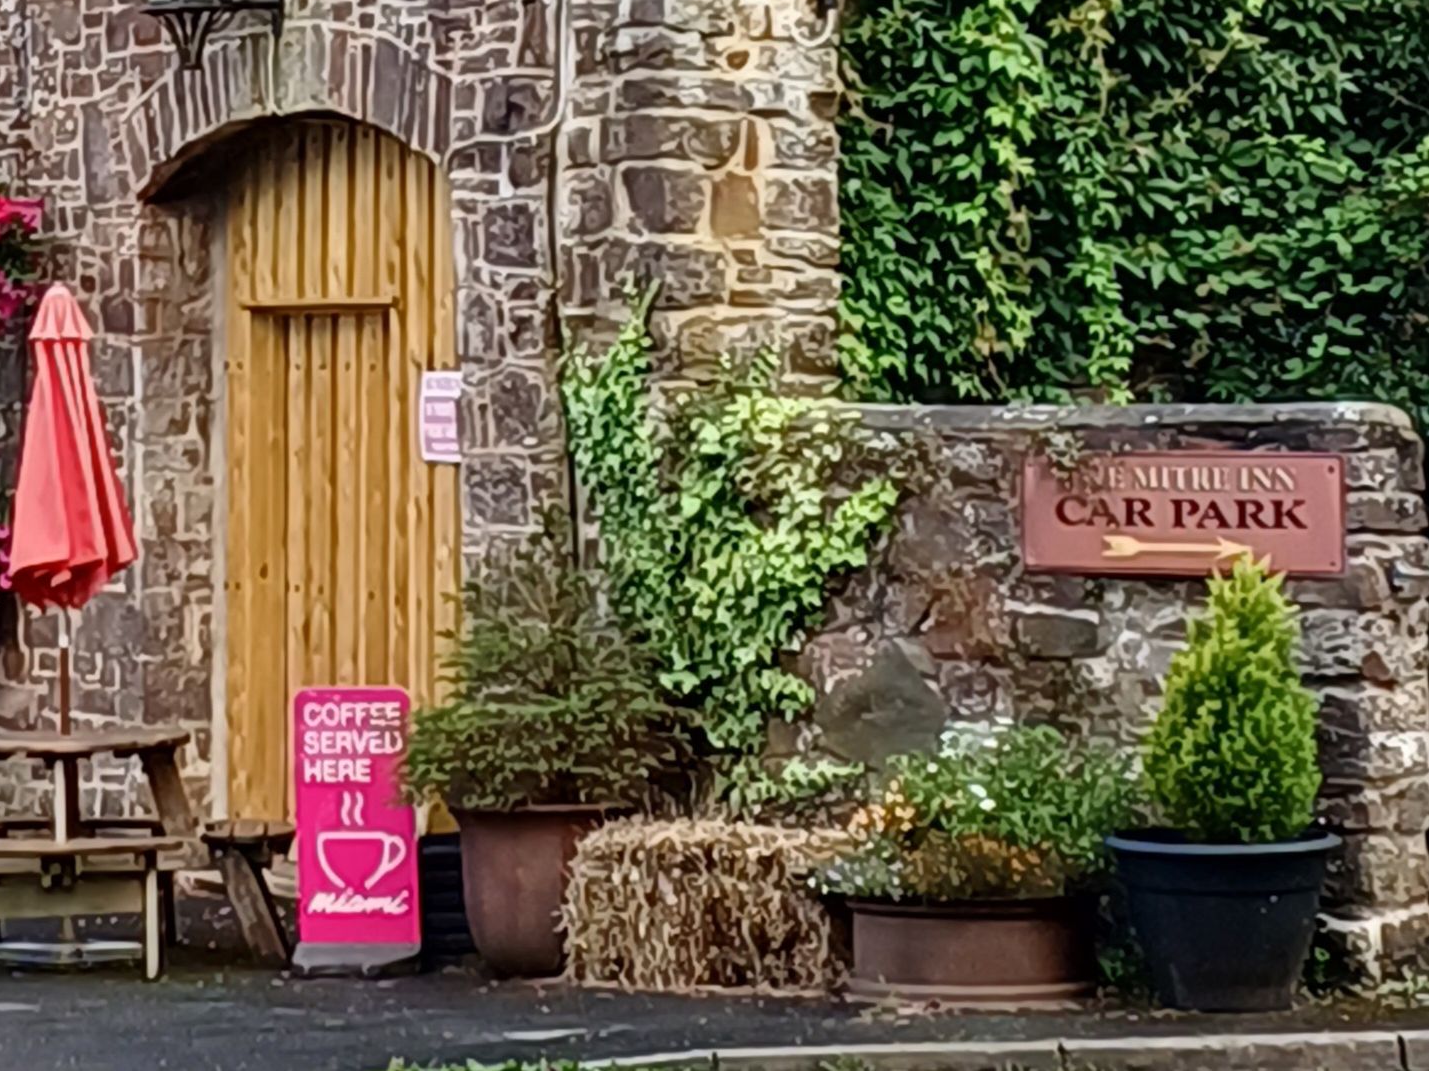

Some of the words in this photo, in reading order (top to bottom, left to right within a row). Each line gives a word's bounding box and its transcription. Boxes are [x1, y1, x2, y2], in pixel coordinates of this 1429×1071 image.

[1134, 466, 1231, 491] MITRE
[1239, 467, 1298, 491] INN
[1054, 495, 1155, 528] CAR
[1169, 498, 1308, 530] PARK
[303, 701, 401, 727] COFFEE
[303, 729, 404, 755] SERVED
[303, 758, 372, 784] HERE
